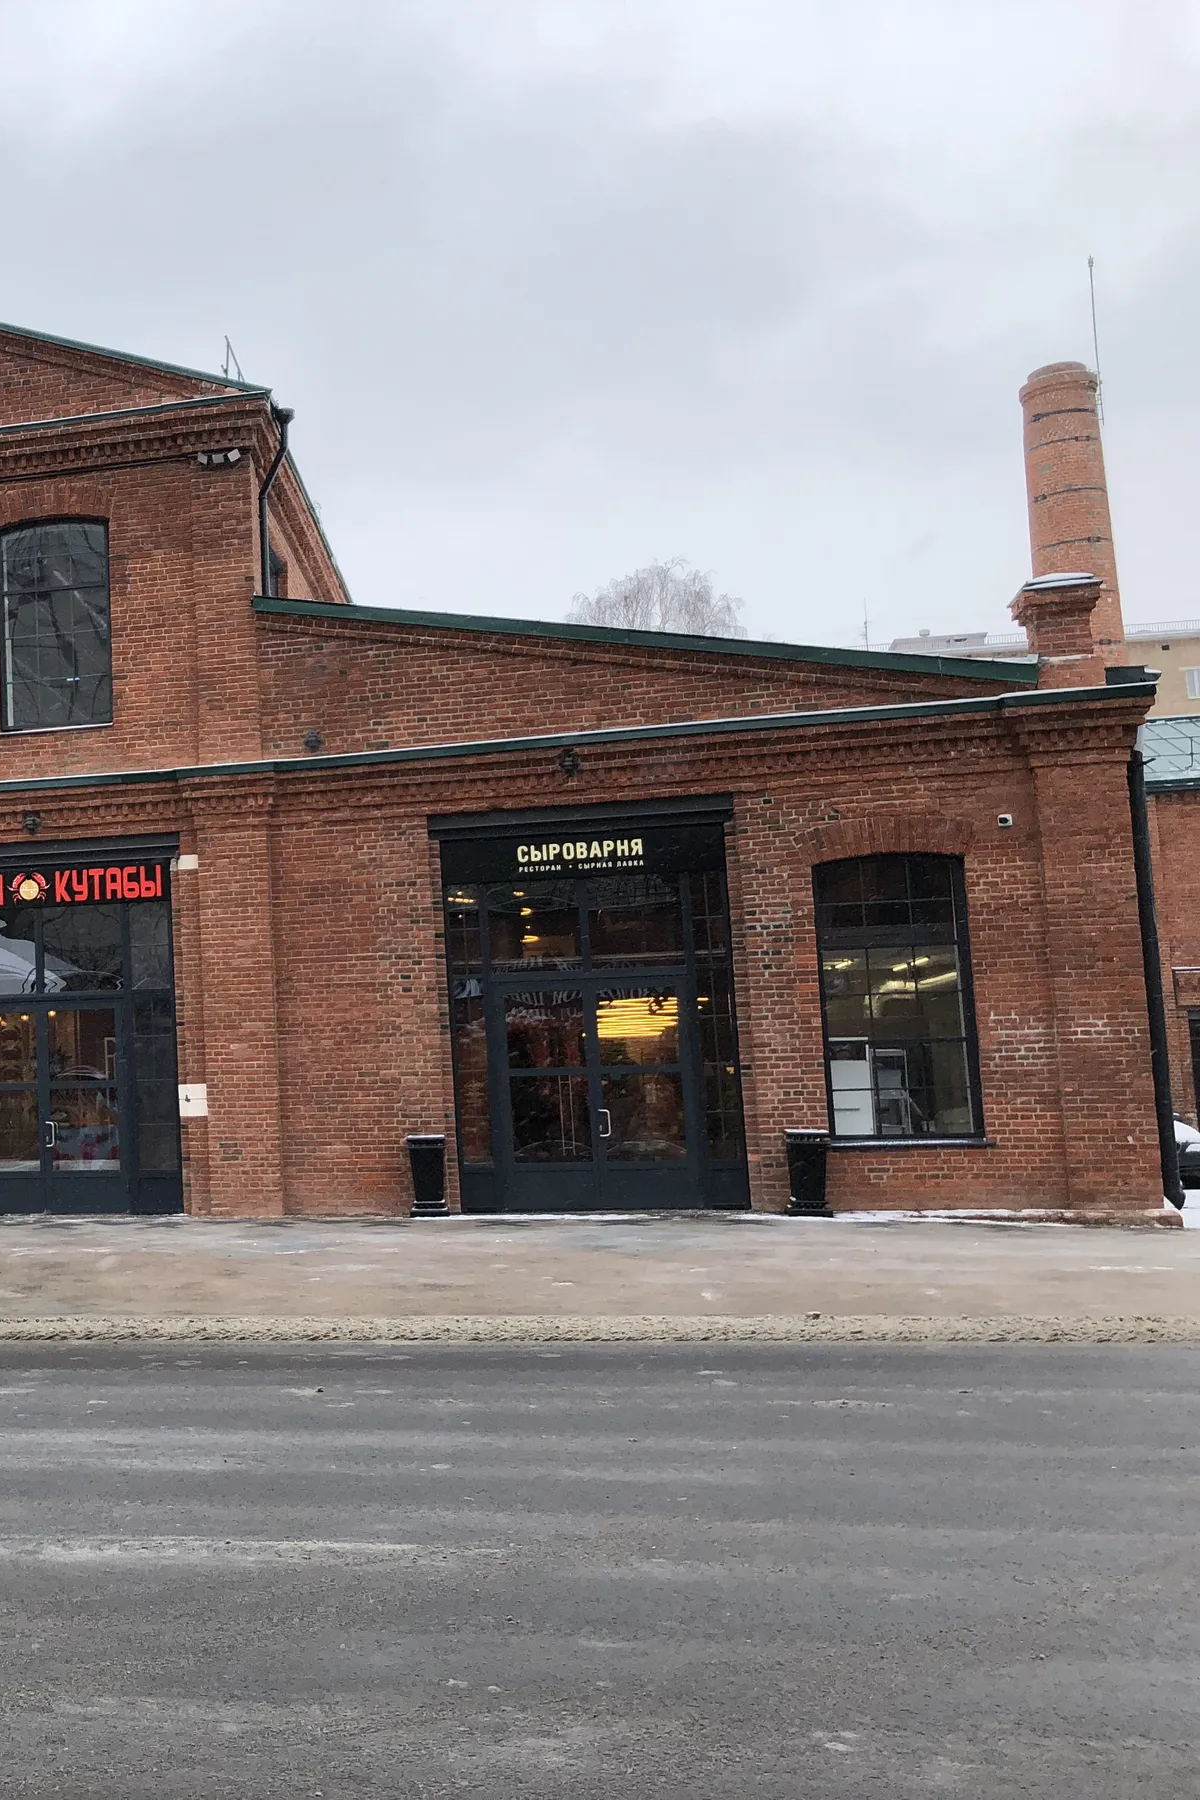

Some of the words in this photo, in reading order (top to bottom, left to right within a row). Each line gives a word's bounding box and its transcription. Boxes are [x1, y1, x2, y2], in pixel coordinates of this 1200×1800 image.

[516, 838, 644, 863] СЫРОВАРНЯ
[518, 864, 562, 873] РЕСТОРАН
[578, 861, 613, 870] СЫРНАЯ
[616, 859, 645, 868] ЛАВКА
[55, 864, 162, 902] КУТАБЫ
